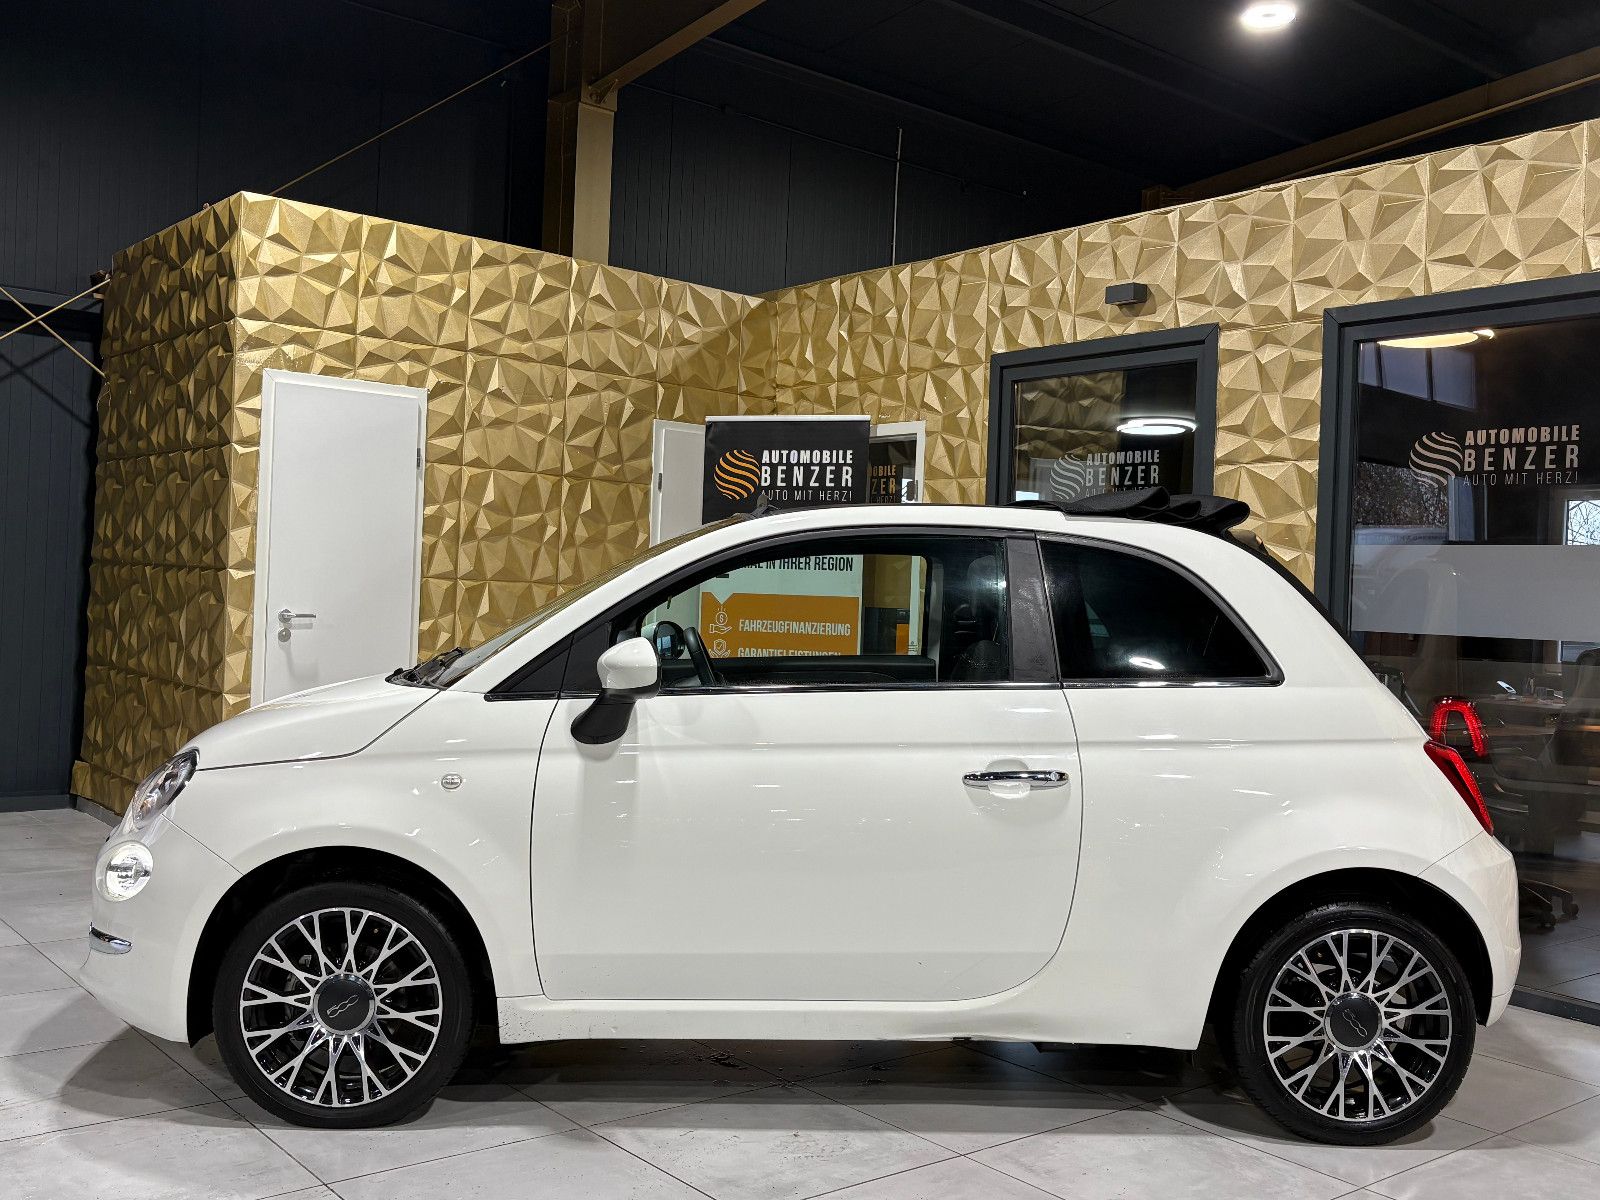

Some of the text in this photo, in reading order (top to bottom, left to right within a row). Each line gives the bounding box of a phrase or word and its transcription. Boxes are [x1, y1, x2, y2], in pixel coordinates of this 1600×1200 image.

[1465, 424, 1580, 446] AUTOMOBILE
[761, 449, 853, 464] AUTOMOBILE
[1087, 450, 1160, 466] AUTOMOBILE
[1463, 444, 1579, 472] BENZER
[760, 465, 853, 487] BENZER
[1085, 465, 1160, 486] BENZER
[1463, 471, 1579, 486] AUTO MIT HERZ!
[794, 490, 813, 501] MIT
[819, 490, 852, 502] HERZ!
[779, 556, 811, 571] IHRER
[813, 556, 854, 572] REGION
[738, 619, 851, 636] FAHRZEUGFINANZIERUNG
